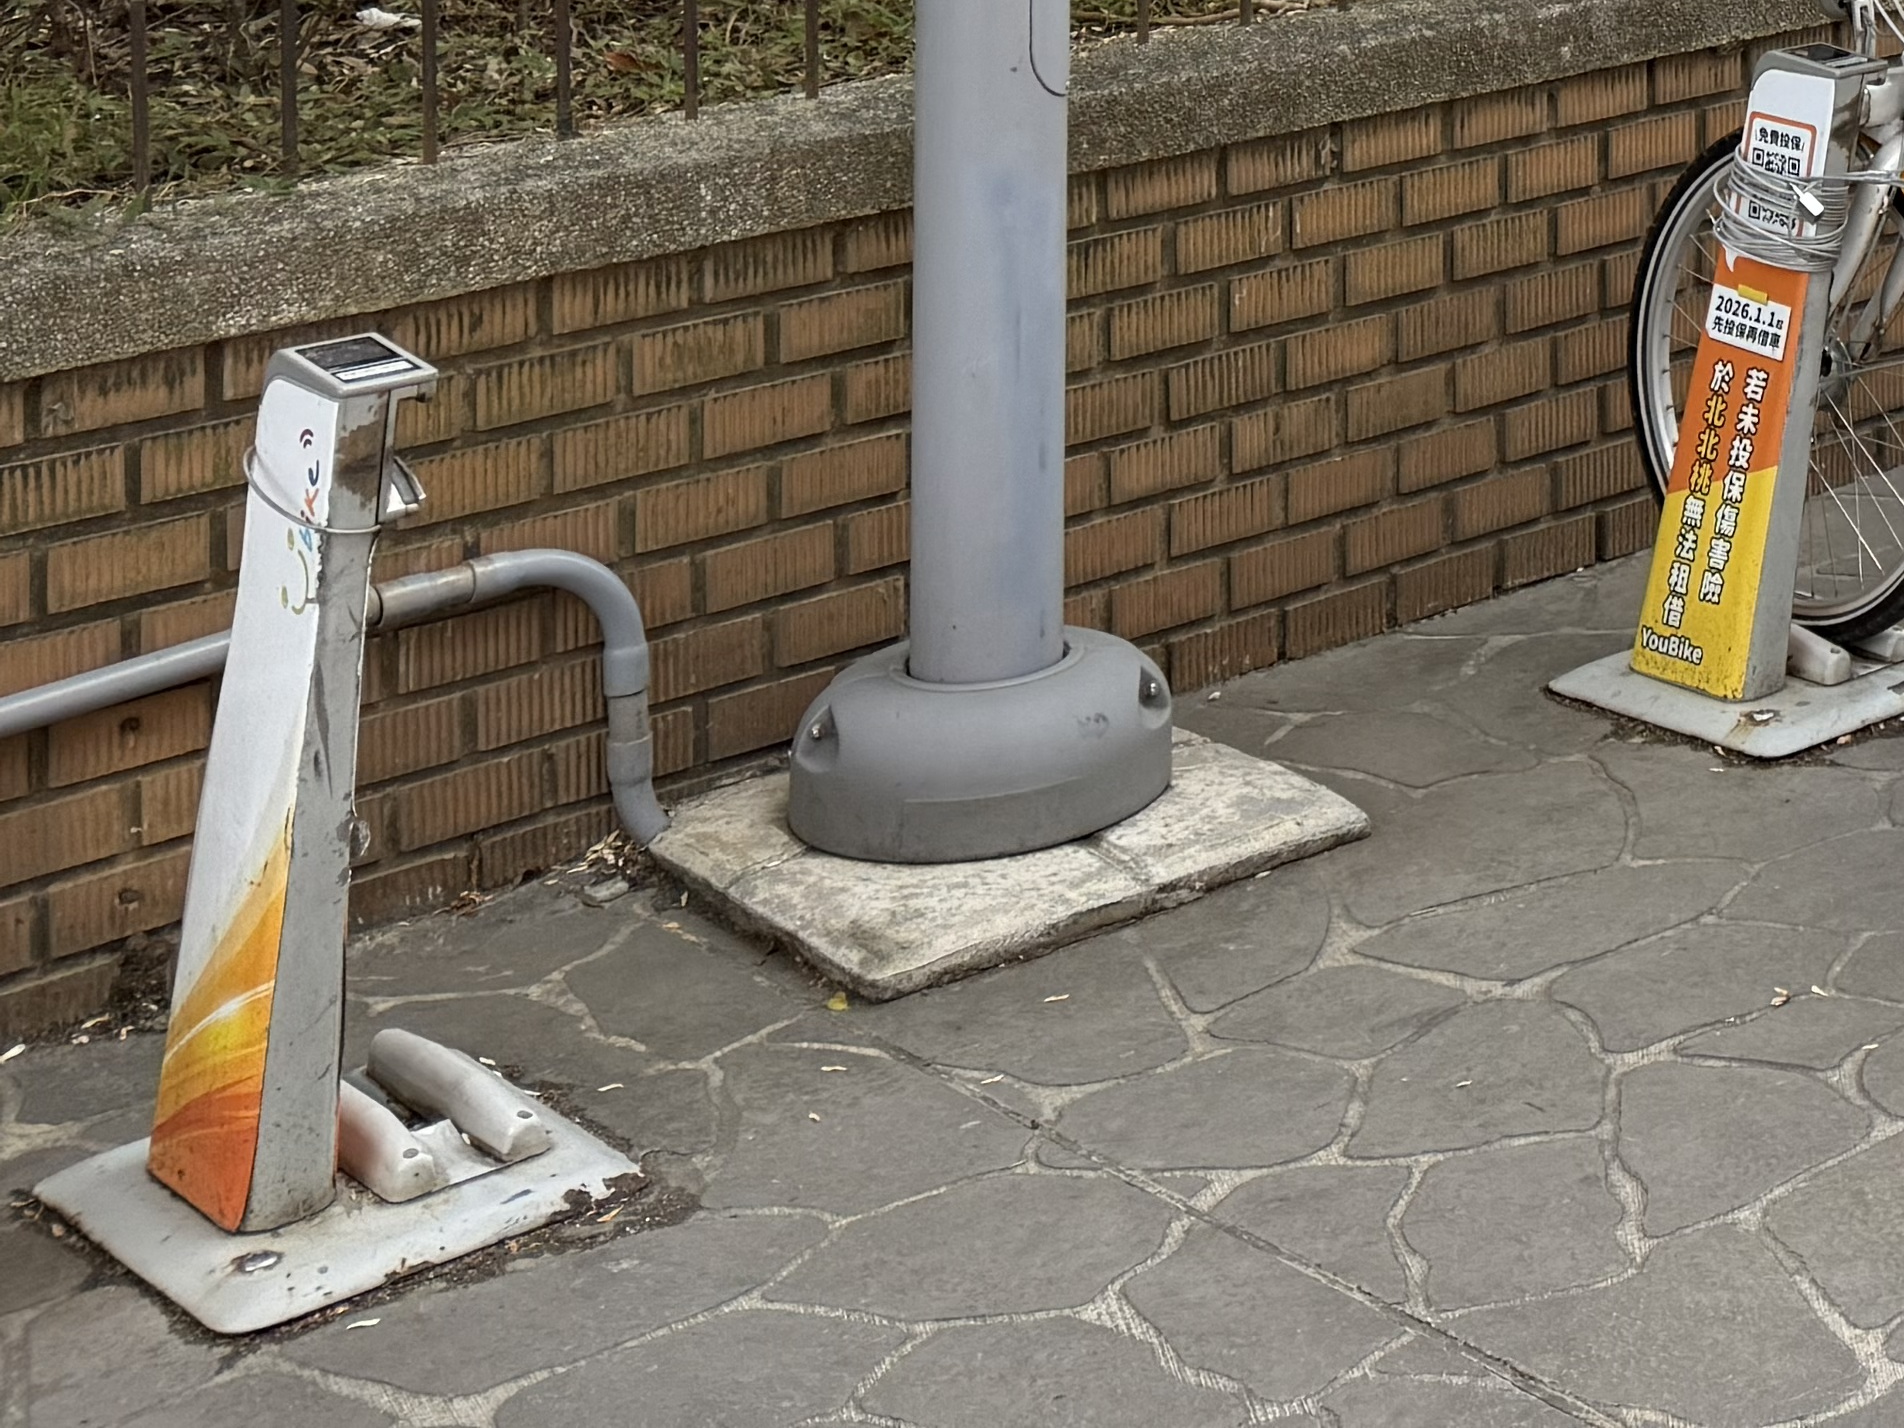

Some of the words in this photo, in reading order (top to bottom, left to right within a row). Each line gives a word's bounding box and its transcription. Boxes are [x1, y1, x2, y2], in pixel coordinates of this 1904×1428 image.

[1758, 126, 1802, 152] 免費投保
[1711, 315, 1781, 350] 先投保再借車
[1662, 359, 1736, 629] 於北北桃無法租借
[1699, 368, 1769, 606] 若未投保傷害險
[1641, 627, 1704, 665] YouBike
